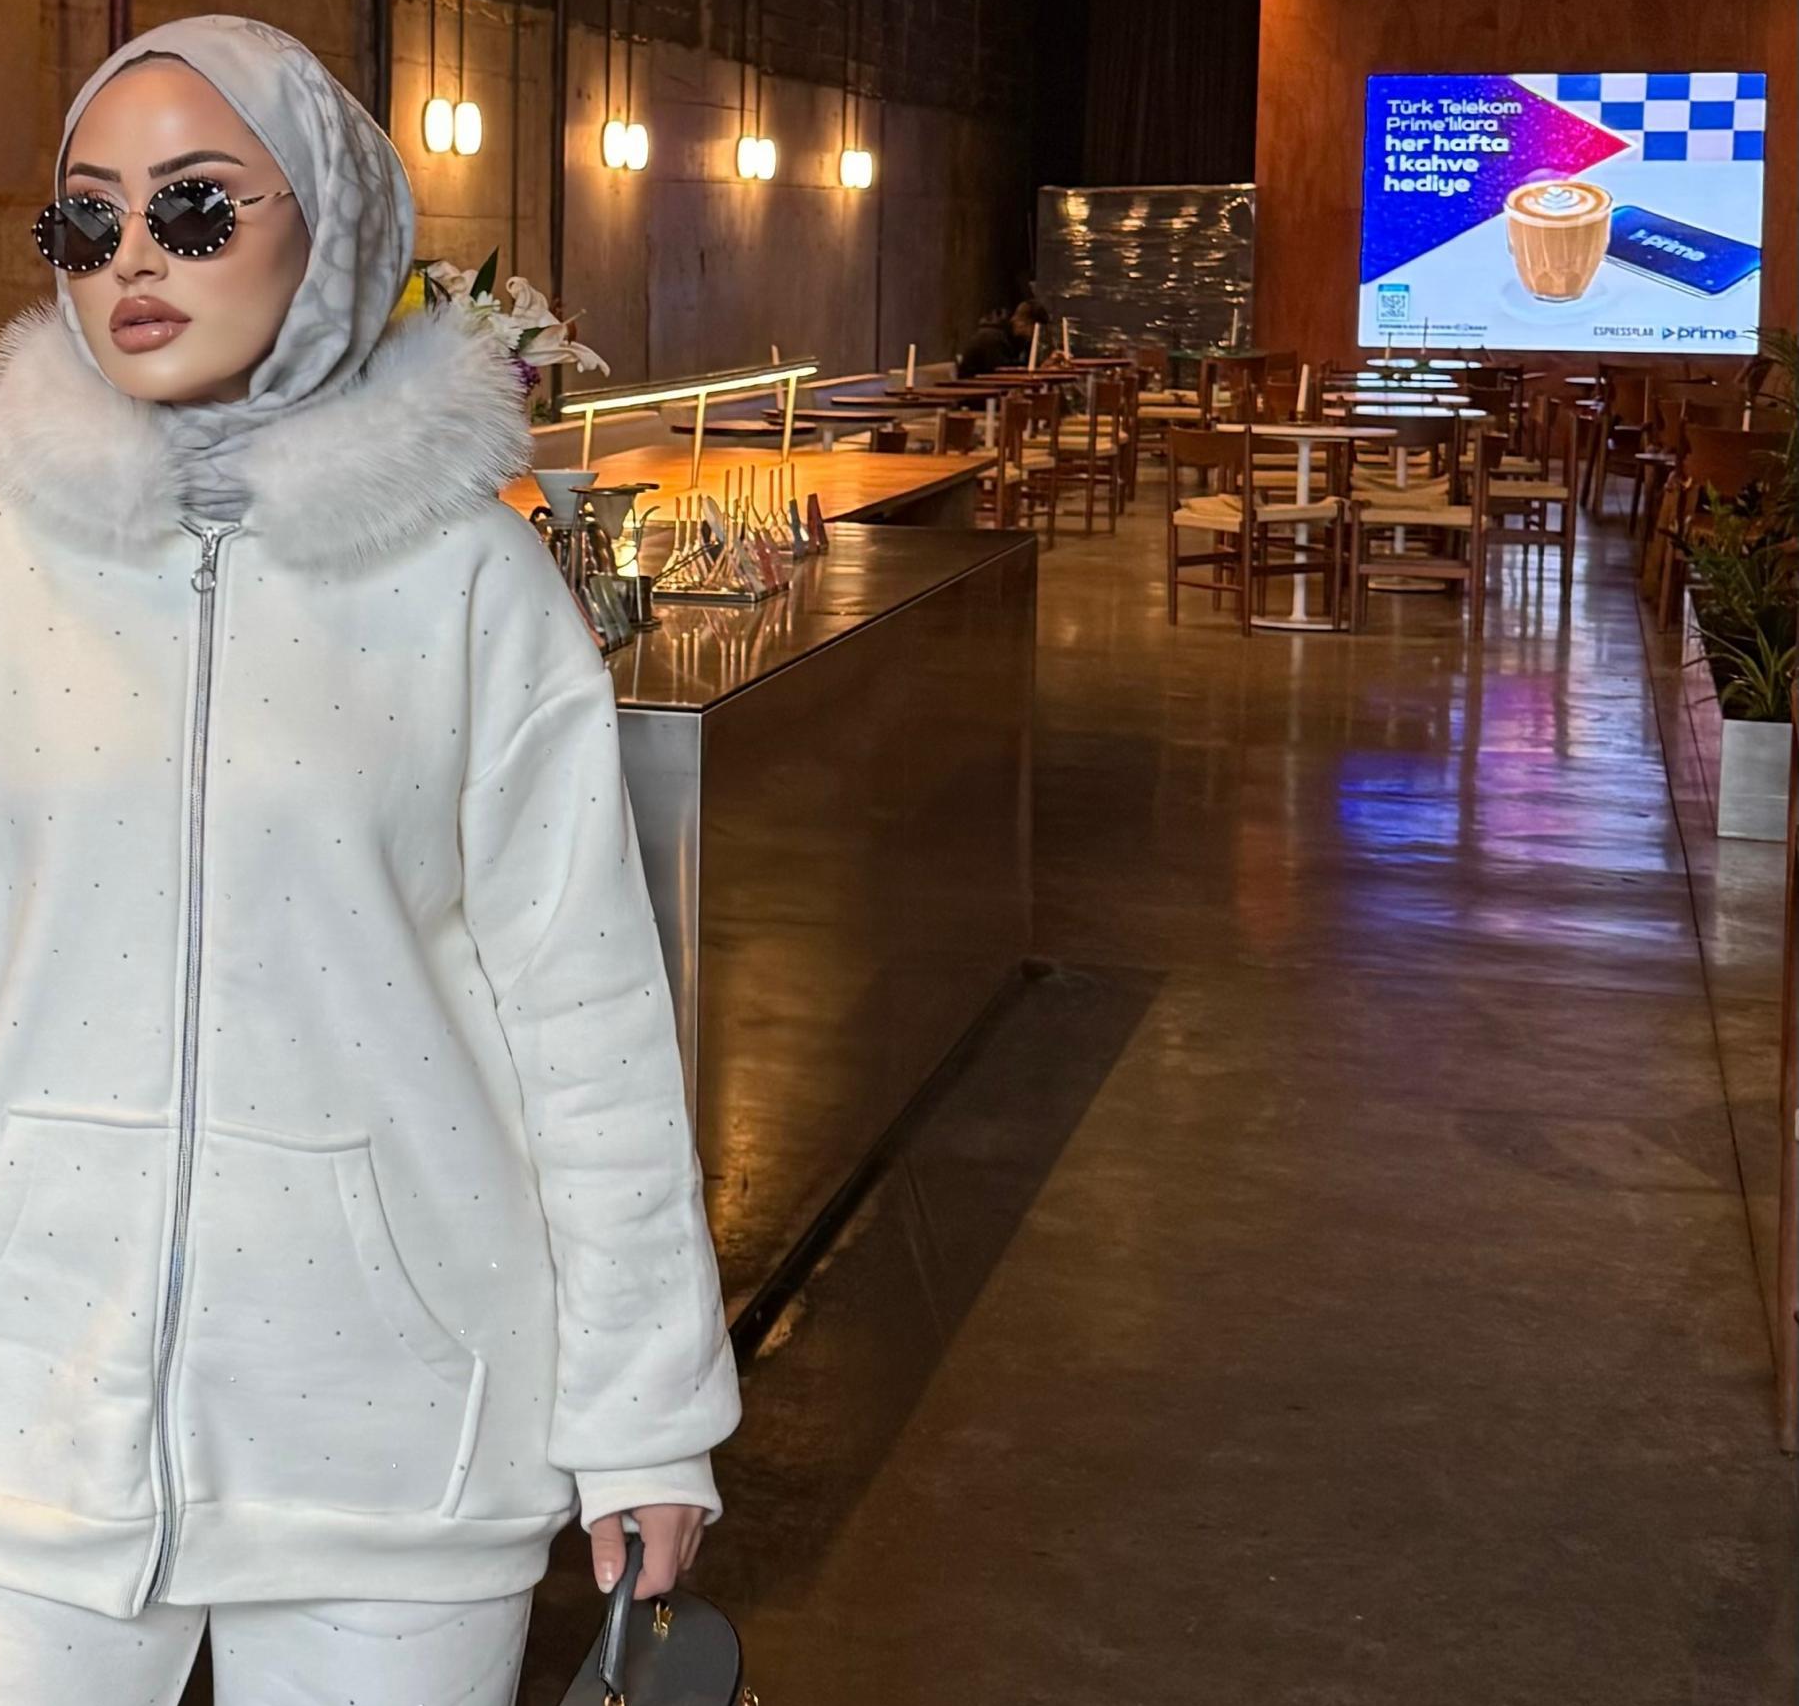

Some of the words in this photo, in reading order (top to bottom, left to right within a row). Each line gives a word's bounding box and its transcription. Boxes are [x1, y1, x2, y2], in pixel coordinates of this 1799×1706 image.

[1386, 98, 1434, 114] Türk
[1438, 98, 1522, 115] Telekom
[1385, 134, 1431, 152] her
[1433, 133, 1510, 152] hafta
[1384, 155, 1396, 172] 1
[1399, 154, 1480, 172] kahve
[1383, 174, 1472, 197] hediye
[1677, 326, 1737, 342] prime
